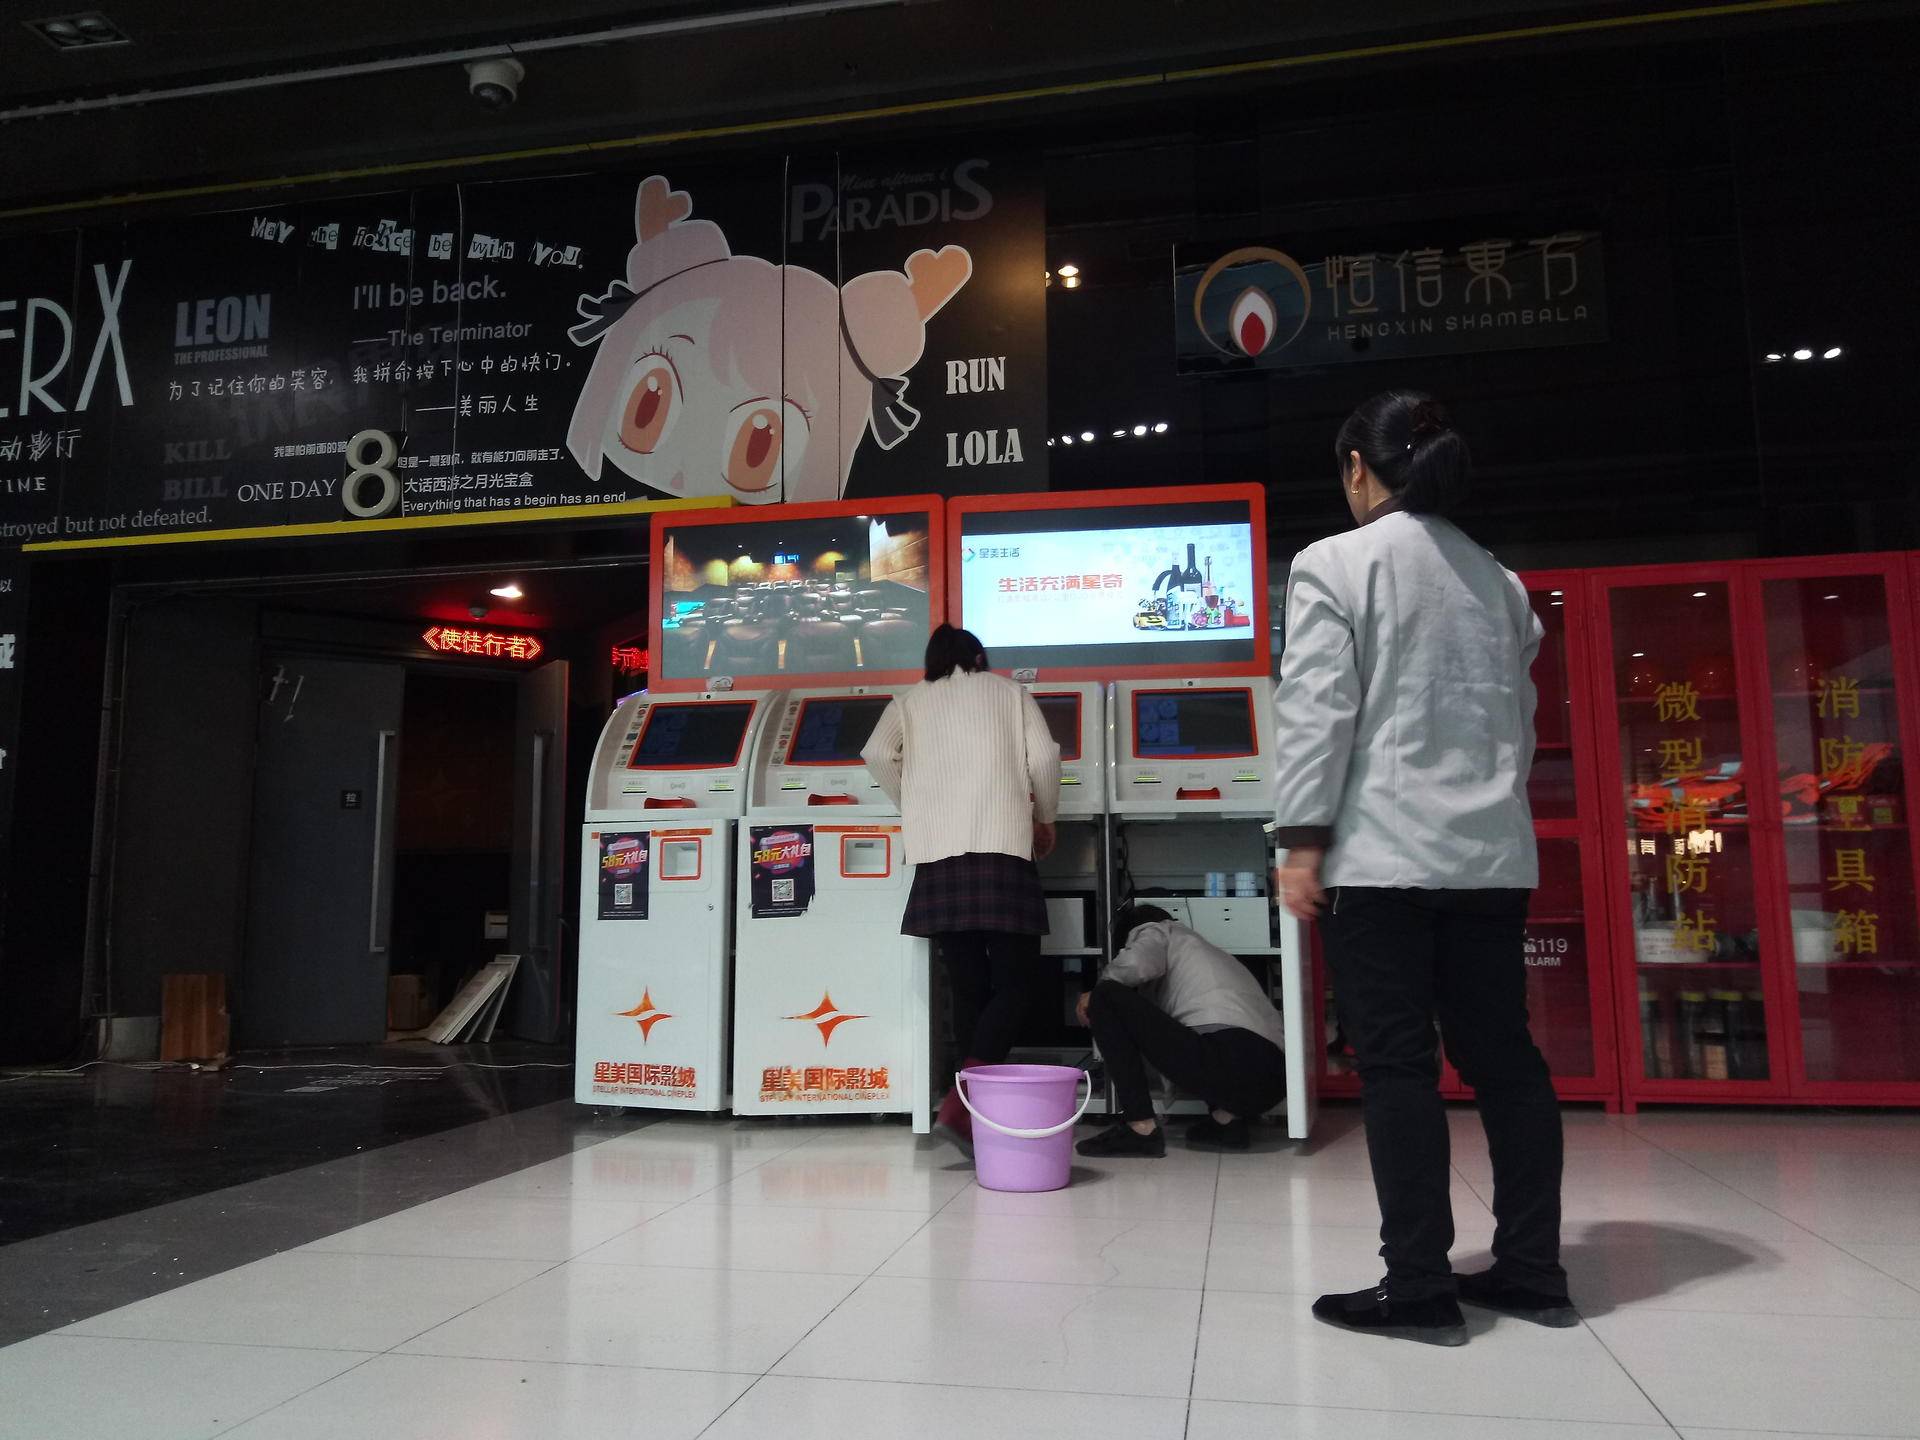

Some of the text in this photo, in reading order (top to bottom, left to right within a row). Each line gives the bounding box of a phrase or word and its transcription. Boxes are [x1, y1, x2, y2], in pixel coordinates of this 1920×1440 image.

[428, 232, 453, 260] be
[353, 274, 508, 311] I'll be back.
[174, 293, 272, 348] LEON
[430, 321, 533, 344] Terminator
[1328, 305, 1589, 341] HENGXIN SHAMBALA
[174, 344, 268, 365] THE PROFESSIONAL
[945, 356, 1007, 395] RUN
[163, 438, 232, 465] KILL
[945, 428, 1024, 468] LOLA
[0, 476, 47, 493] IME
[342, 429, 403, 518] 8
[404, 471, 534, 494] 大话西游之月光宝盒
[162, 476, 228, 500] BILL
[236, 478, 337, 503] ONE DAY
[403, 491, 627, 514] Everything that has a begin has an end
[65, 516, 95, 534] but
[99, 513, 127, 531] not
[131, 506, 213, 528] defeated.
[998, 573, 1123, 592] 生活充满星奇
[1654, 680, 1717, 953] 微型消防站
[1816, 676, 1880, 955] 消防工具箱
[601, 849, 648, 869] 58元大礼包
[752, 843, 812, 864] 58元大礼包
[1537, 938, 1568, 953] 119
[593, 1061, 697, 1088] 星美国际影城
[760, 1066, 890, 1091] 星美国际影城
